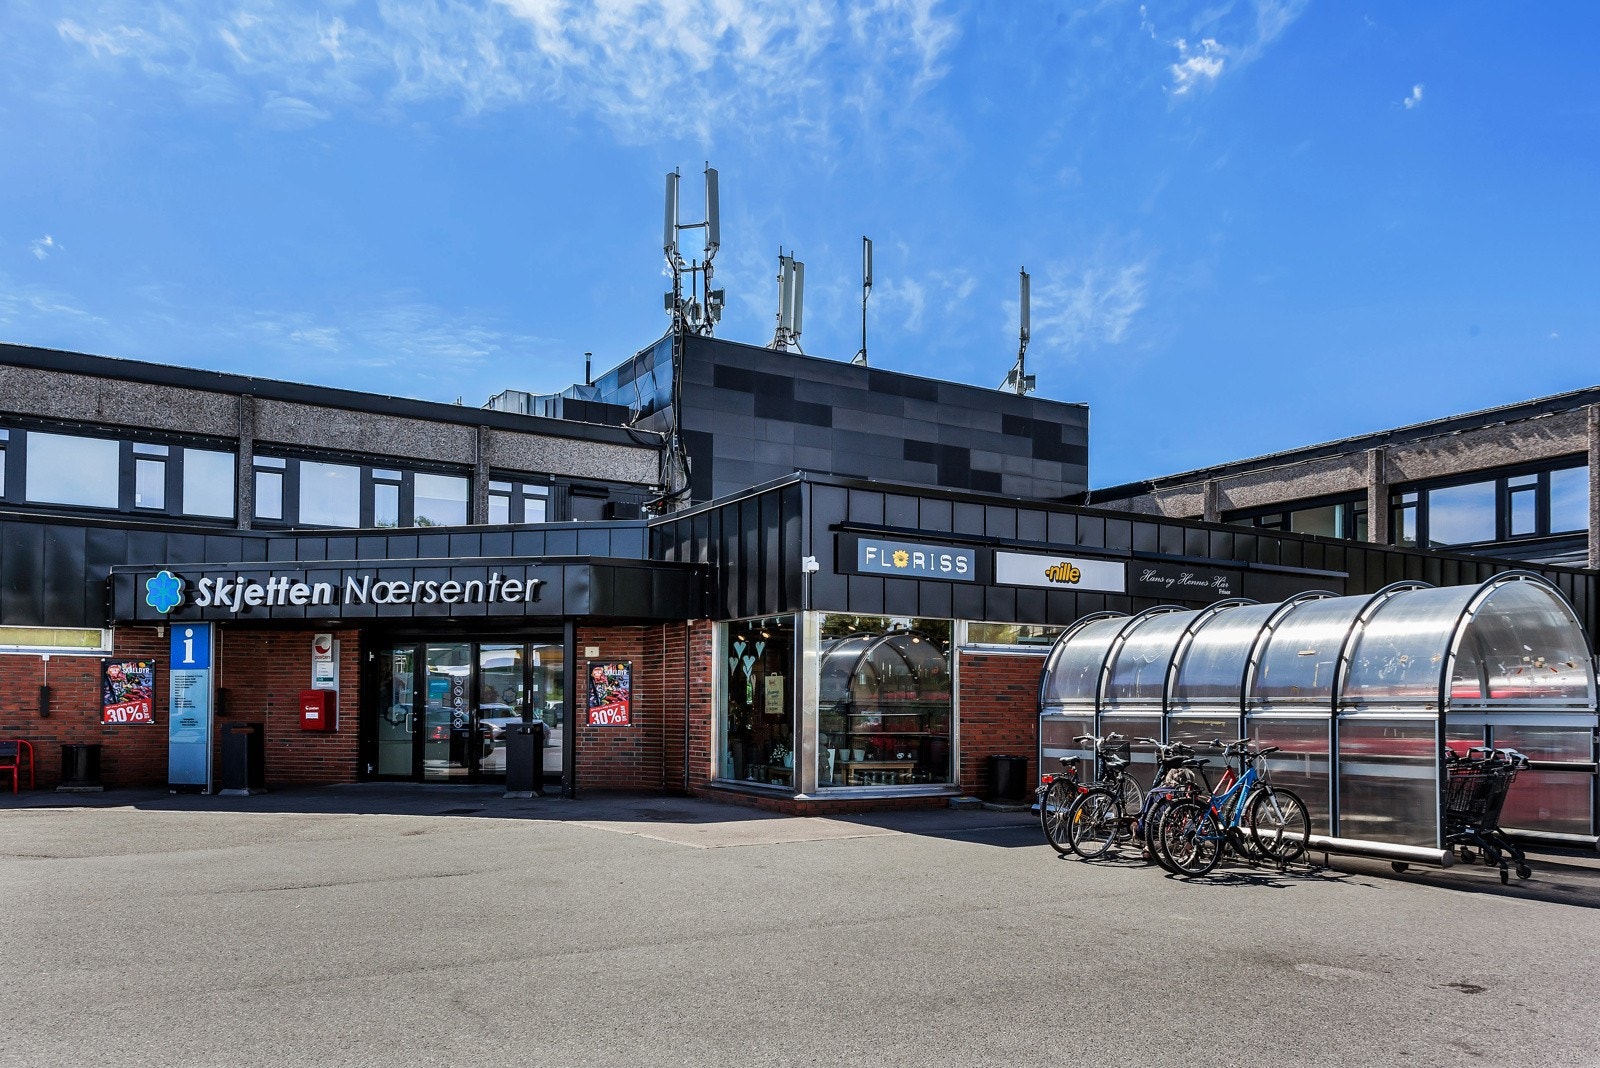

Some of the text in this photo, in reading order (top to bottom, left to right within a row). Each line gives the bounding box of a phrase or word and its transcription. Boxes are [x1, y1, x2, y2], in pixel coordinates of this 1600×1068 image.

[866, 547, 968, 573] FLORISS
[1140, 569, 1165, 582] Hans
[1165, 577, 1176, 589] og
[1178, 573, 1209, 587] Hennes
[195, 572, 540, 612] Skjetten Nærsenter
[106, 705, 143, 722] 30%
[591, 708, 621, 724] 30%
